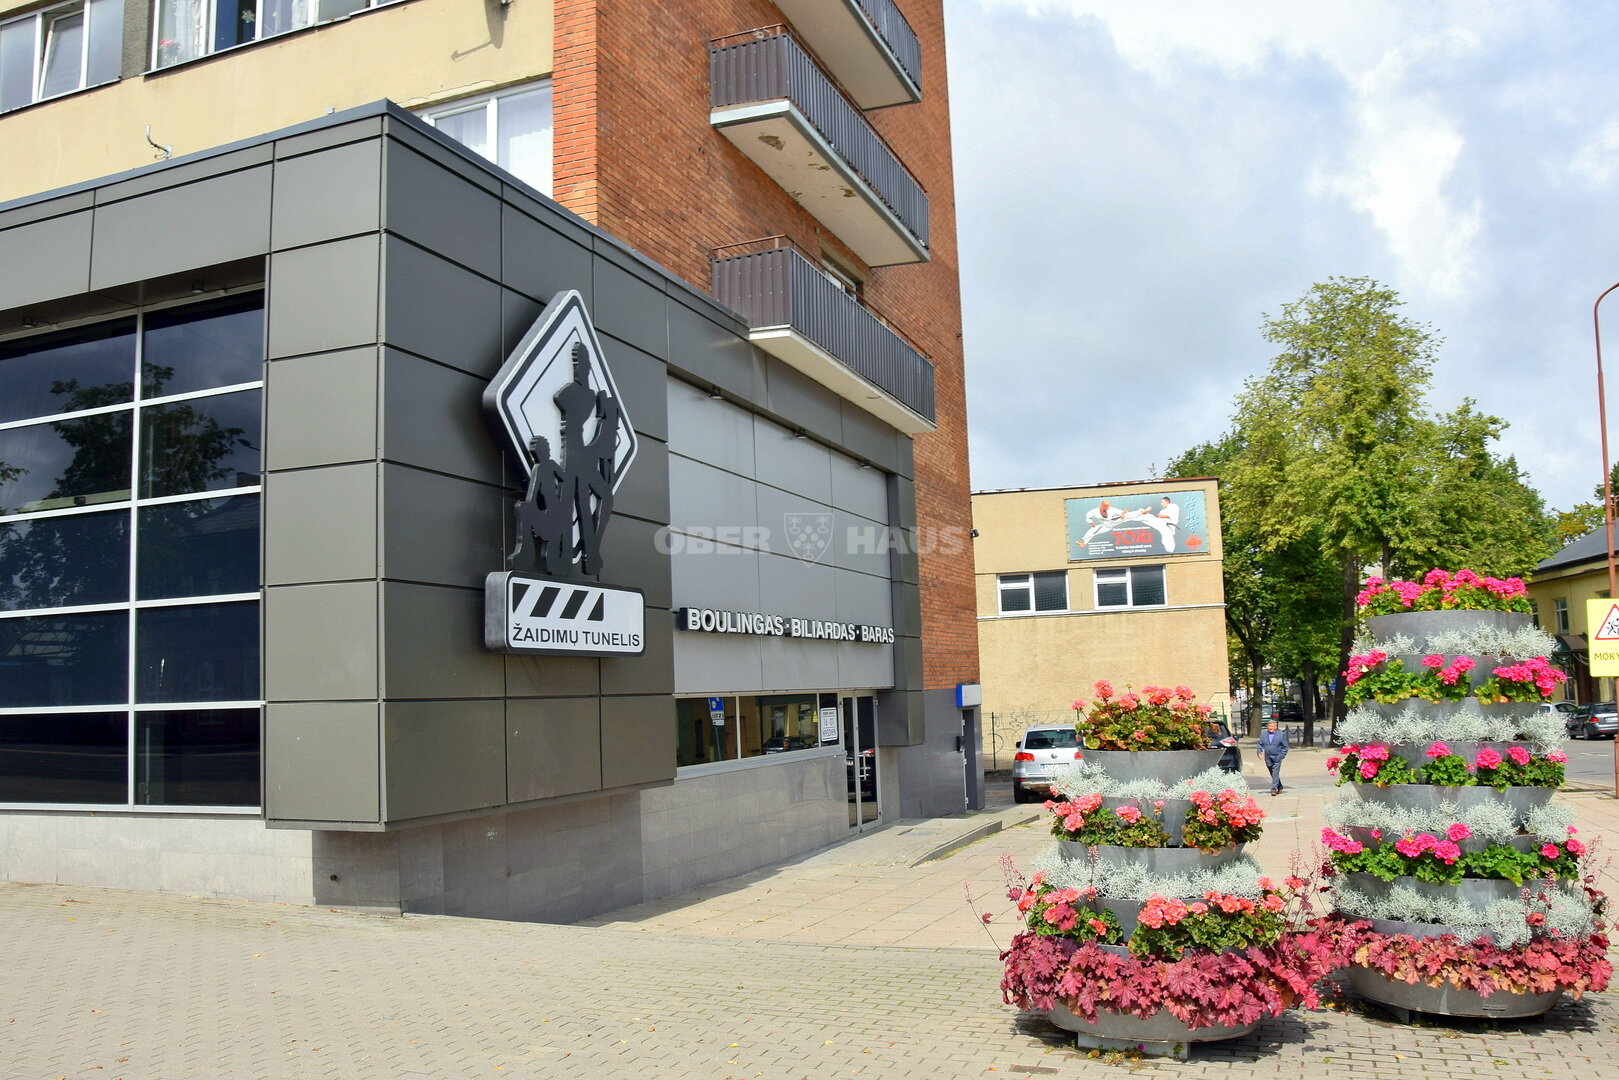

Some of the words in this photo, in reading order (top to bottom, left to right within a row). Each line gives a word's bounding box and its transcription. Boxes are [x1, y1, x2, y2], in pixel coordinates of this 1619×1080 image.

[512, 623, 579, 646] ŽAIDIMŲ
[582, 631, 640, 647] TUNELIS
[686, 607, 784, 636] BOULINGAS
[791, 617, 856, 641] BILIARDAS
[861, 625, 895, 644] BARAS
